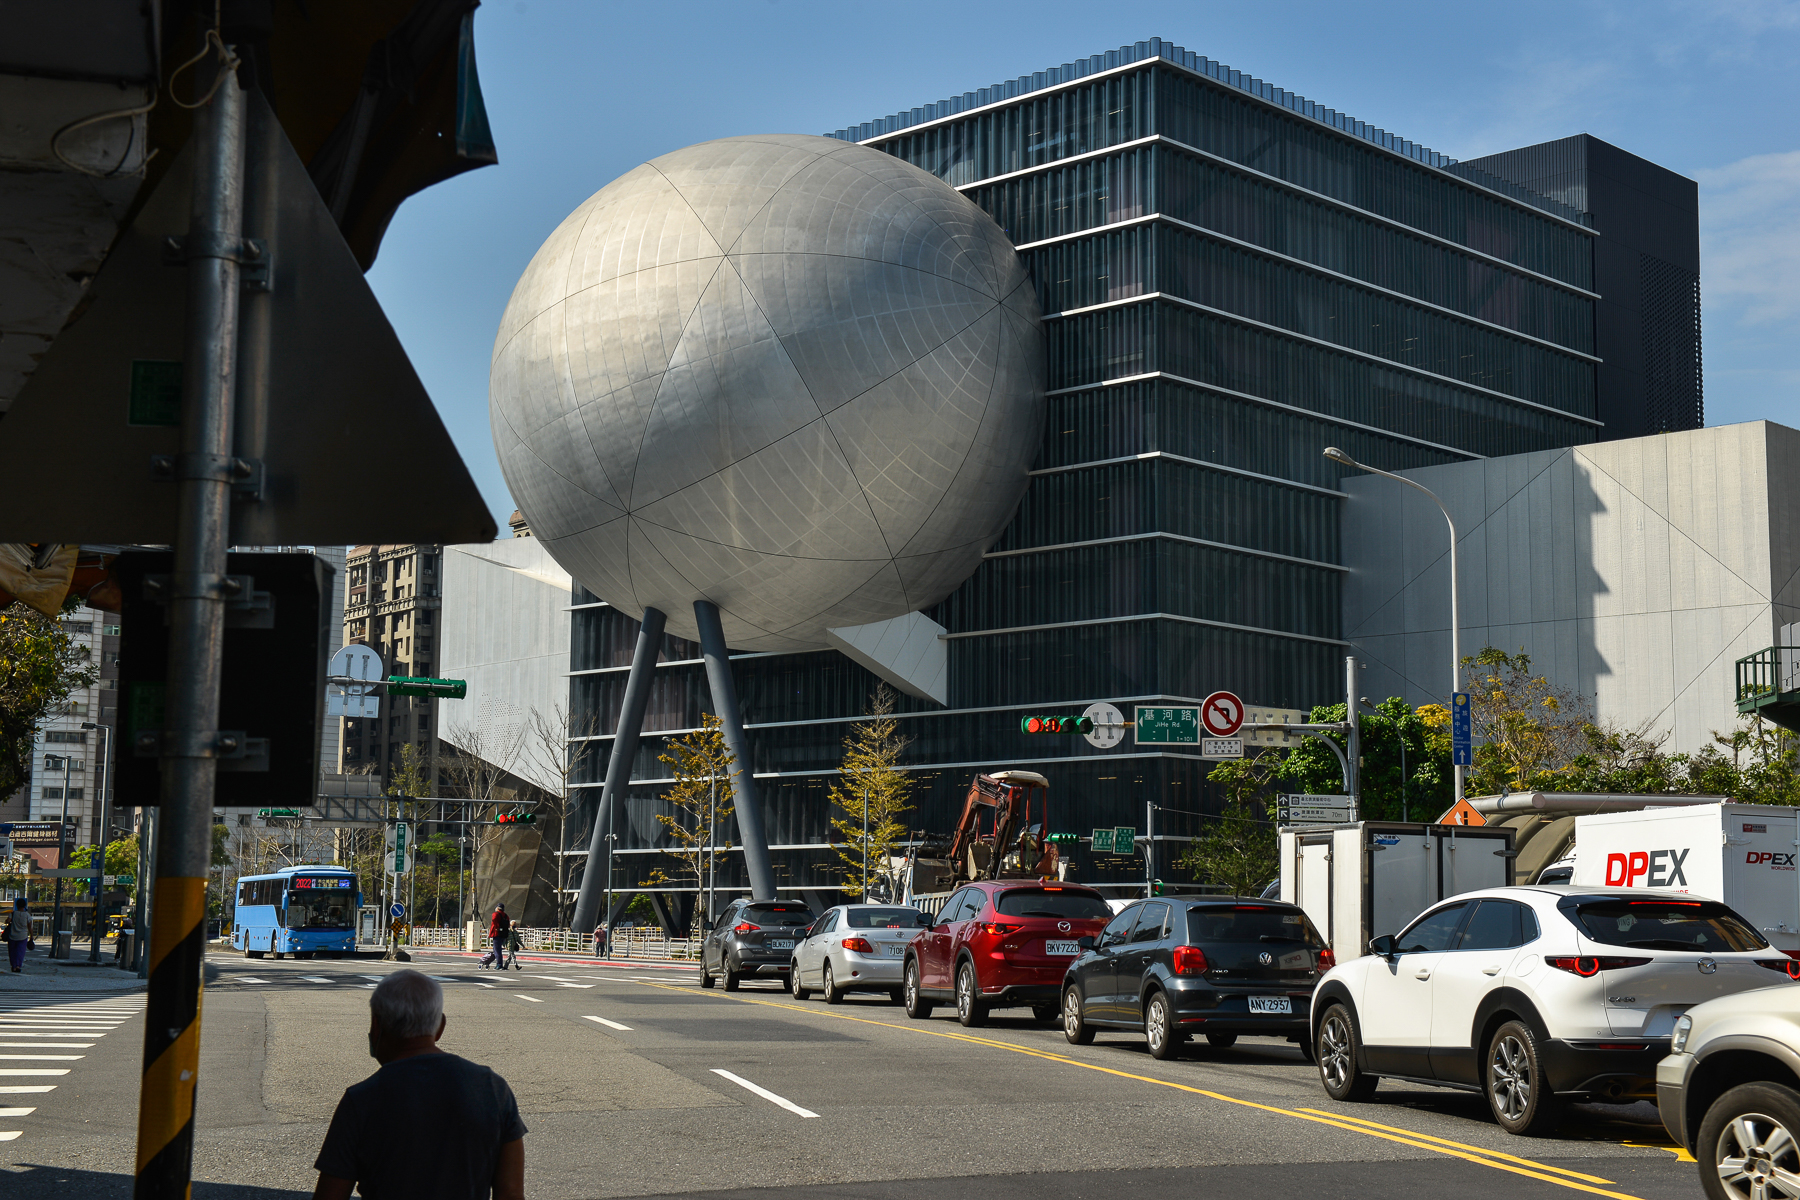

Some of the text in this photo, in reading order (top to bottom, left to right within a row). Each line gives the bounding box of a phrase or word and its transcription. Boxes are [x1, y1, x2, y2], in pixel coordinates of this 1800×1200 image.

[1144, 709, 1192, 721] 基河路
[397, 828, 405, 856] 基河路
[1746, 851, 1796, 866] DPEX
[1605, 848, 1690, 887] DPEX
[296, 878, 312, 889] 2022
[1250, 999, 1290, 1011] ANY-2937
